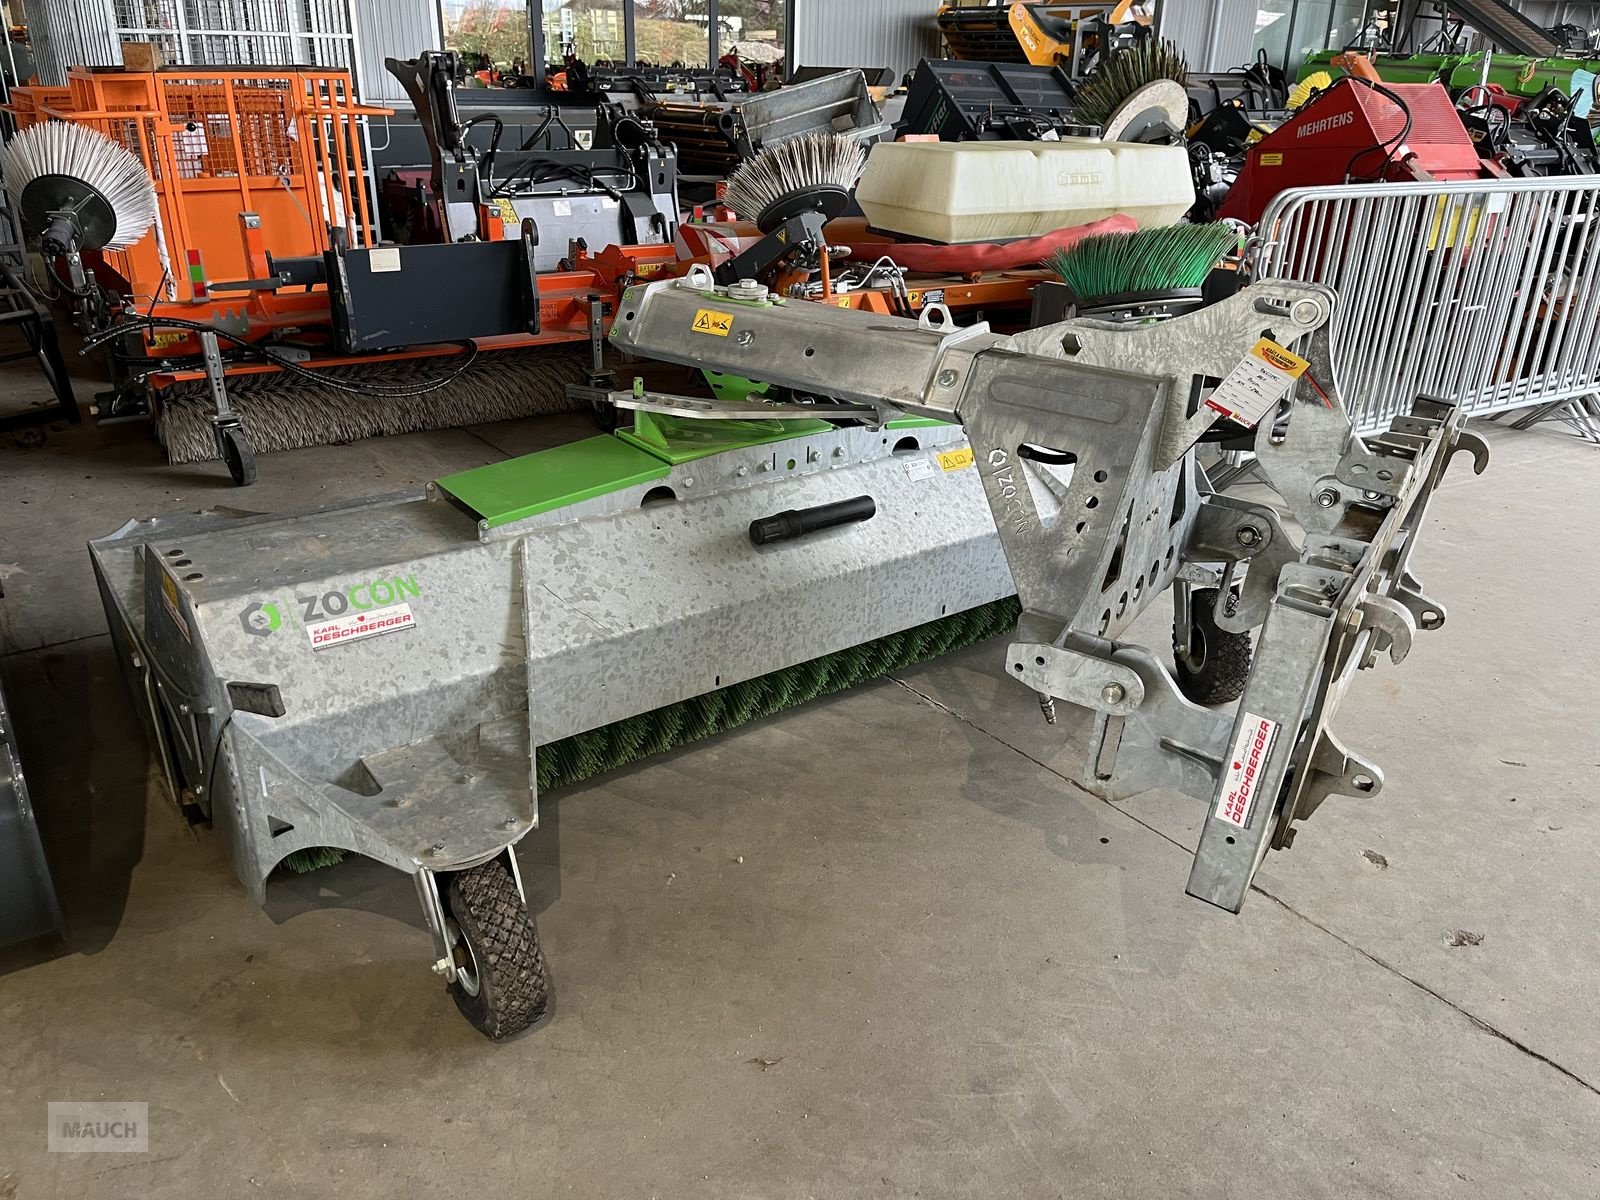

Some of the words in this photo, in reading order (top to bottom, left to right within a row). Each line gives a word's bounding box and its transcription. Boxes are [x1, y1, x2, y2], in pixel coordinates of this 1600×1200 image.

[1297, 110, 1354, 139] MEHRTENS
[297, 574, 422, 623] ZOCON
[313, 614, 411, 644] DESCHBERGER
[313, 624, 341, 636] KARL
[1232, 720, 1270, 824] DESCHBERGER
[1224, 791, 1238, 817] KARL
